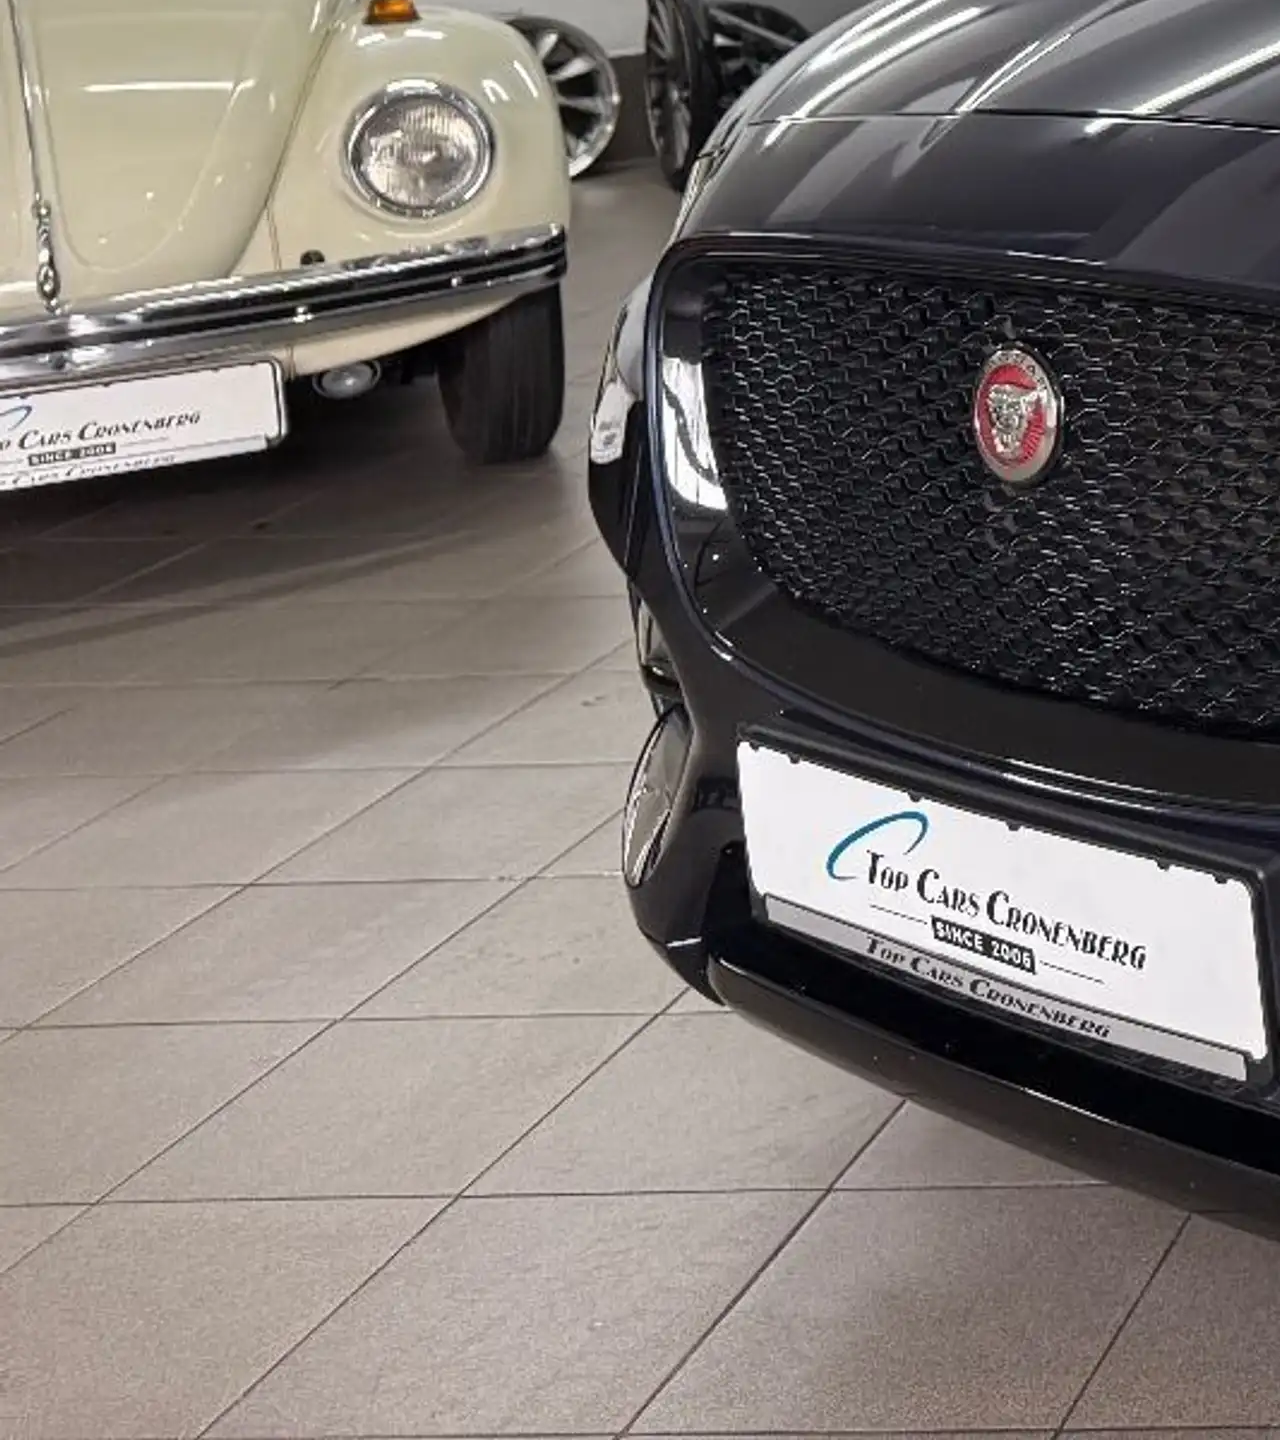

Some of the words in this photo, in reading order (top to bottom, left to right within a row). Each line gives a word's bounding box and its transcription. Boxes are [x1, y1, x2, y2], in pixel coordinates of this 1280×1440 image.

[867, 849, 909, 891] TOP
[917, 868, 980, 917] CARS
[986, 890, 1147, 970] CRONENBERG
[935, 920, 984, 950] SINCE
[865, 936, 905, 965] TOP
[909, 951, 963, 988] CARS
[969, 979, 1111, 1039] CRONENBERG
